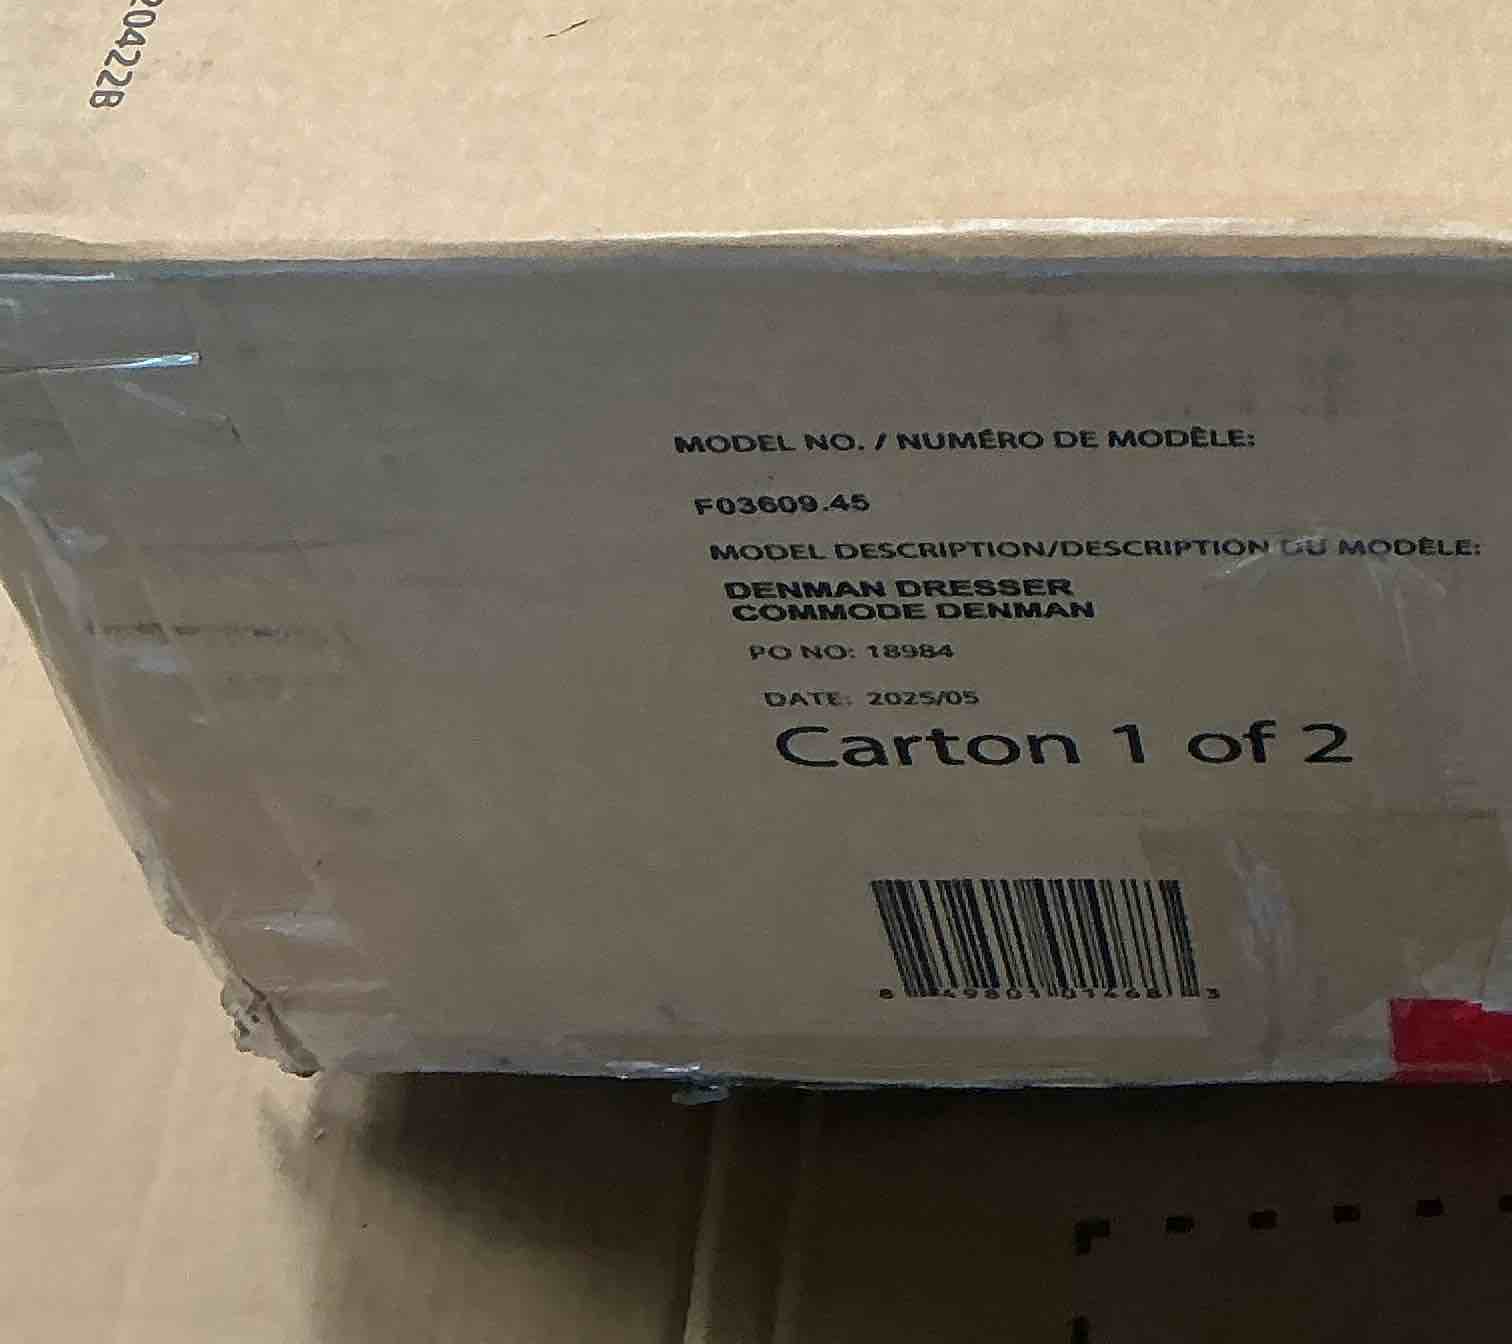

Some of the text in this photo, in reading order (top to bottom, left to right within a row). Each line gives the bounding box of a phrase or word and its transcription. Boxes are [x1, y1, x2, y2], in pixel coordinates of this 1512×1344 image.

[673, 425, 1256, 455] MODEL NO. NUMÉRO DE MODÈLE:
[693, 493, 871, 516] F03609.45
[709, 543, 828, 564] MODEL
[833, 538, 1270, 561] DESCRIPTION/DESCRIPTION
[1338, 535, 1481, 557] MODÈLE:
[723, 578, 1075, 601] DENMAN DRESSER
[731, 599, 1095, 623] COMMODE DENMAN
[747, 643, 955, 661] PO NO: 18984
[866, 689, 980, 707] 2025/05
[775, 719, 1354, 768] Carton 1 of 2
